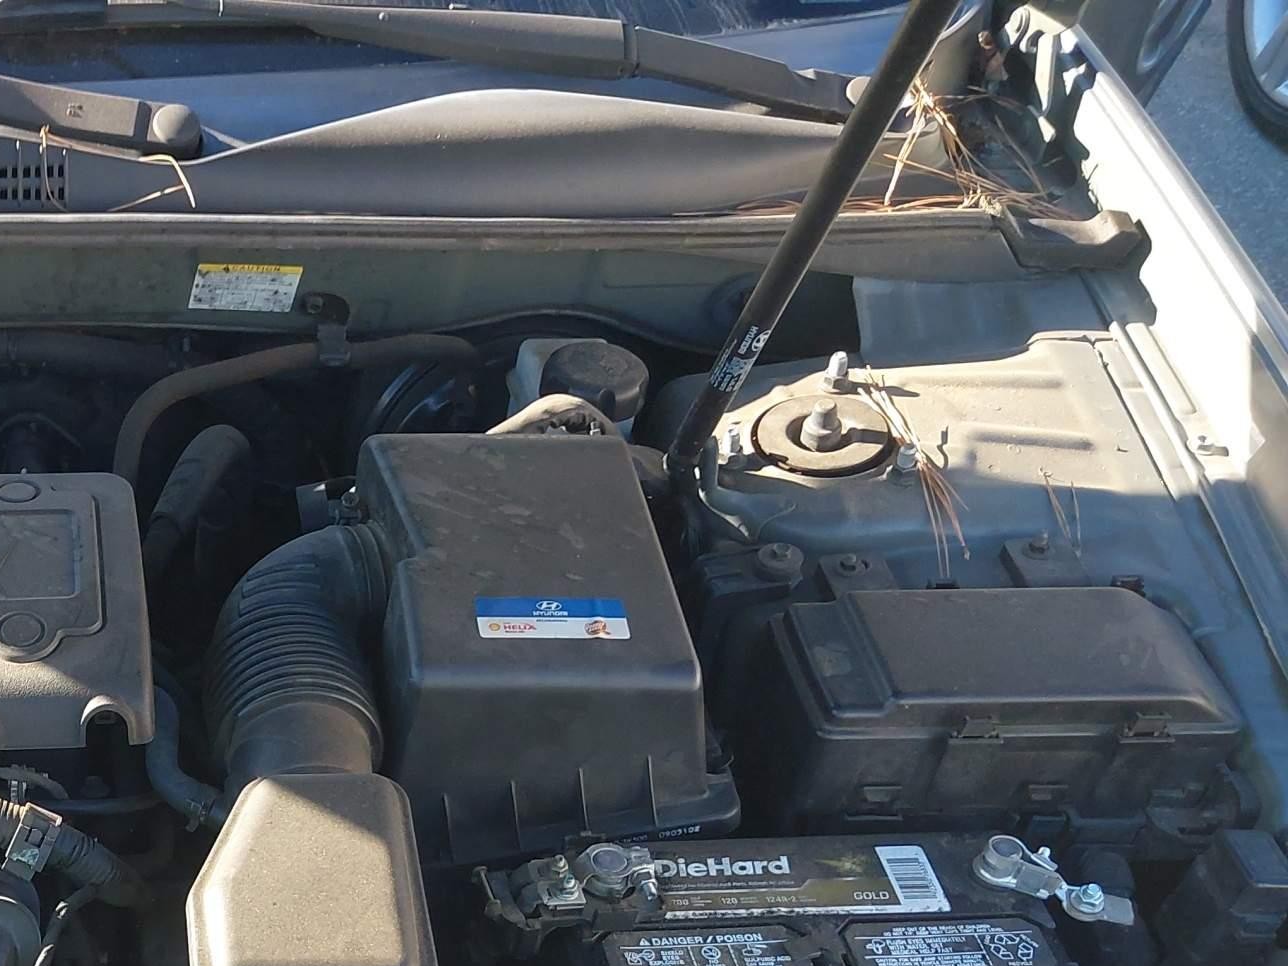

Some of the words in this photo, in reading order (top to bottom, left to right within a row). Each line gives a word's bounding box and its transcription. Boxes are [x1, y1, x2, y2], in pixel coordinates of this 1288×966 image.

[655, 855, 791, 878] DieHard
[720, 896, 738, 905] 120
[854, 890, 890, 901] GOLD
[652, 935, 703, 946] DANGER
[716, 933, 763, 943] POISON
